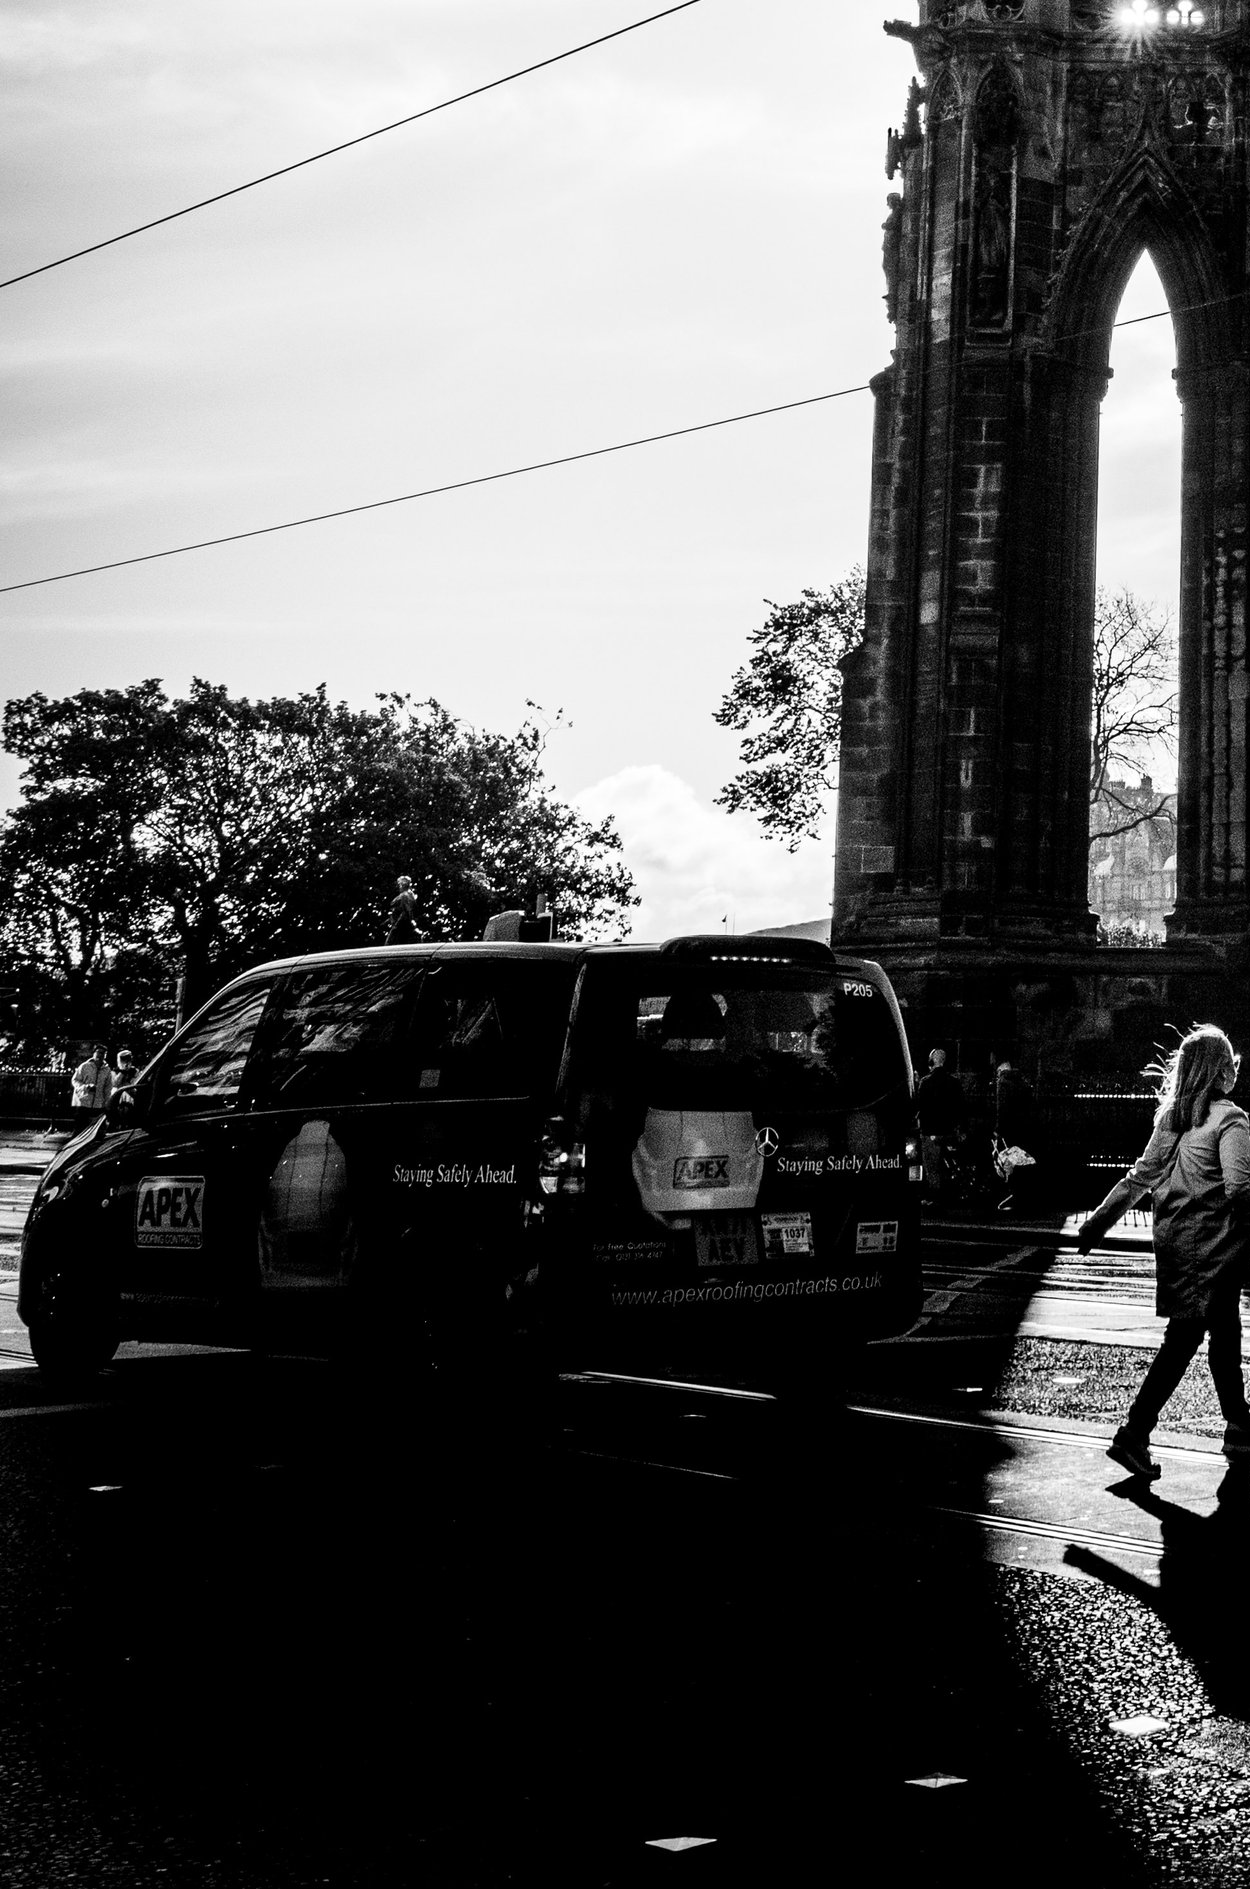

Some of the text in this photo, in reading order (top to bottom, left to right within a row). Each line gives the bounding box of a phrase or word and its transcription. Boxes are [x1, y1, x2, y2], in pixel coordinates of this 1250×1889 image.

[843, 982, 873, 997] P205
[392, 1163, 517, 1188] Staying Safely Ahead.
[676, 1160, 729, 1181] APEX
[777, 1154, 902, 1176] Staying Safely Ahead.
[138, 1187, 201, 1227] APEX
[785, 1227, 805, 1239] 1037
[611, 1271, 883, 1308] www.apexroofingcontracts.co.uk
